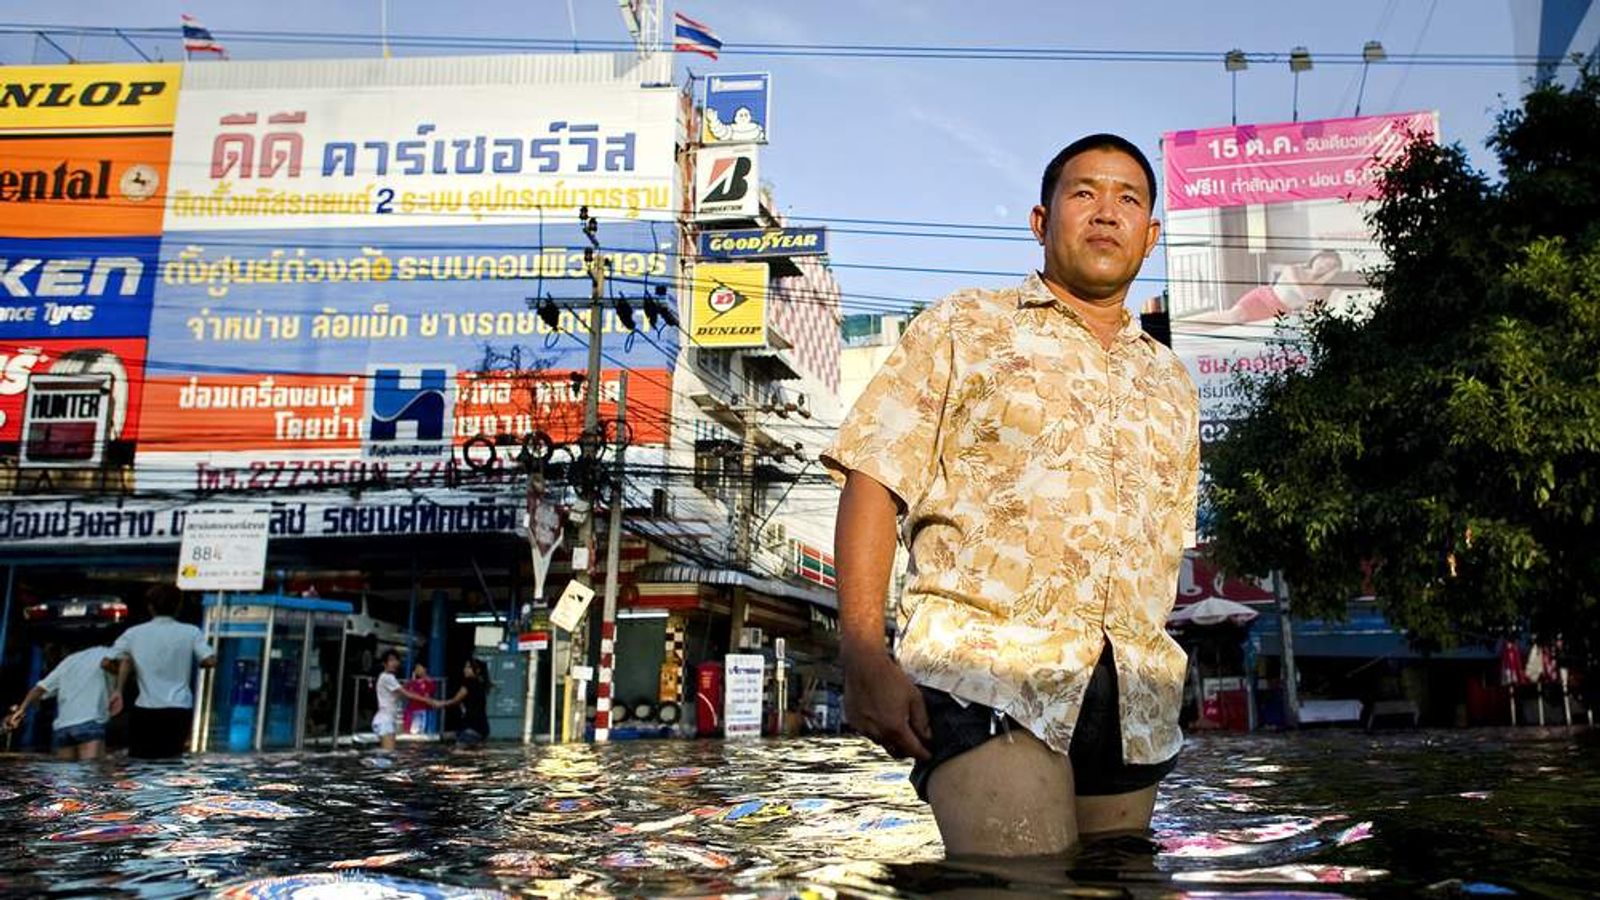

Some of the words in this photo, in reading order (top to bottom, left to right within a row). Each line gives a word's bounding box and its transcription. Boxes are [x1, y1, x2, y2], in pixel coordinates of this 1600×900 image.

[0, 82, 166, 108] NLOP
[210, 111, 307, 178] ดีดี
[322, 121, 637, 177] คาร์เซอร์วิส
[1208, 138, 1239, 159] 15
[0, 160, 111, 201] ental
[376, 188, 395, 214] 2
[400, 188, 462, 213] ระบบ
[44, 302, 96, 326] Tyres
[187, 307, 300, 341] จำหน่าย
[311, 303, 409, 339] ล้อแม็ก
[696, 325, 763, 336] DUNLOP
[179, 375, 360, 409] ซ่อมเครื่องยนต์
[31, 393, 101, 419] HUNTER
